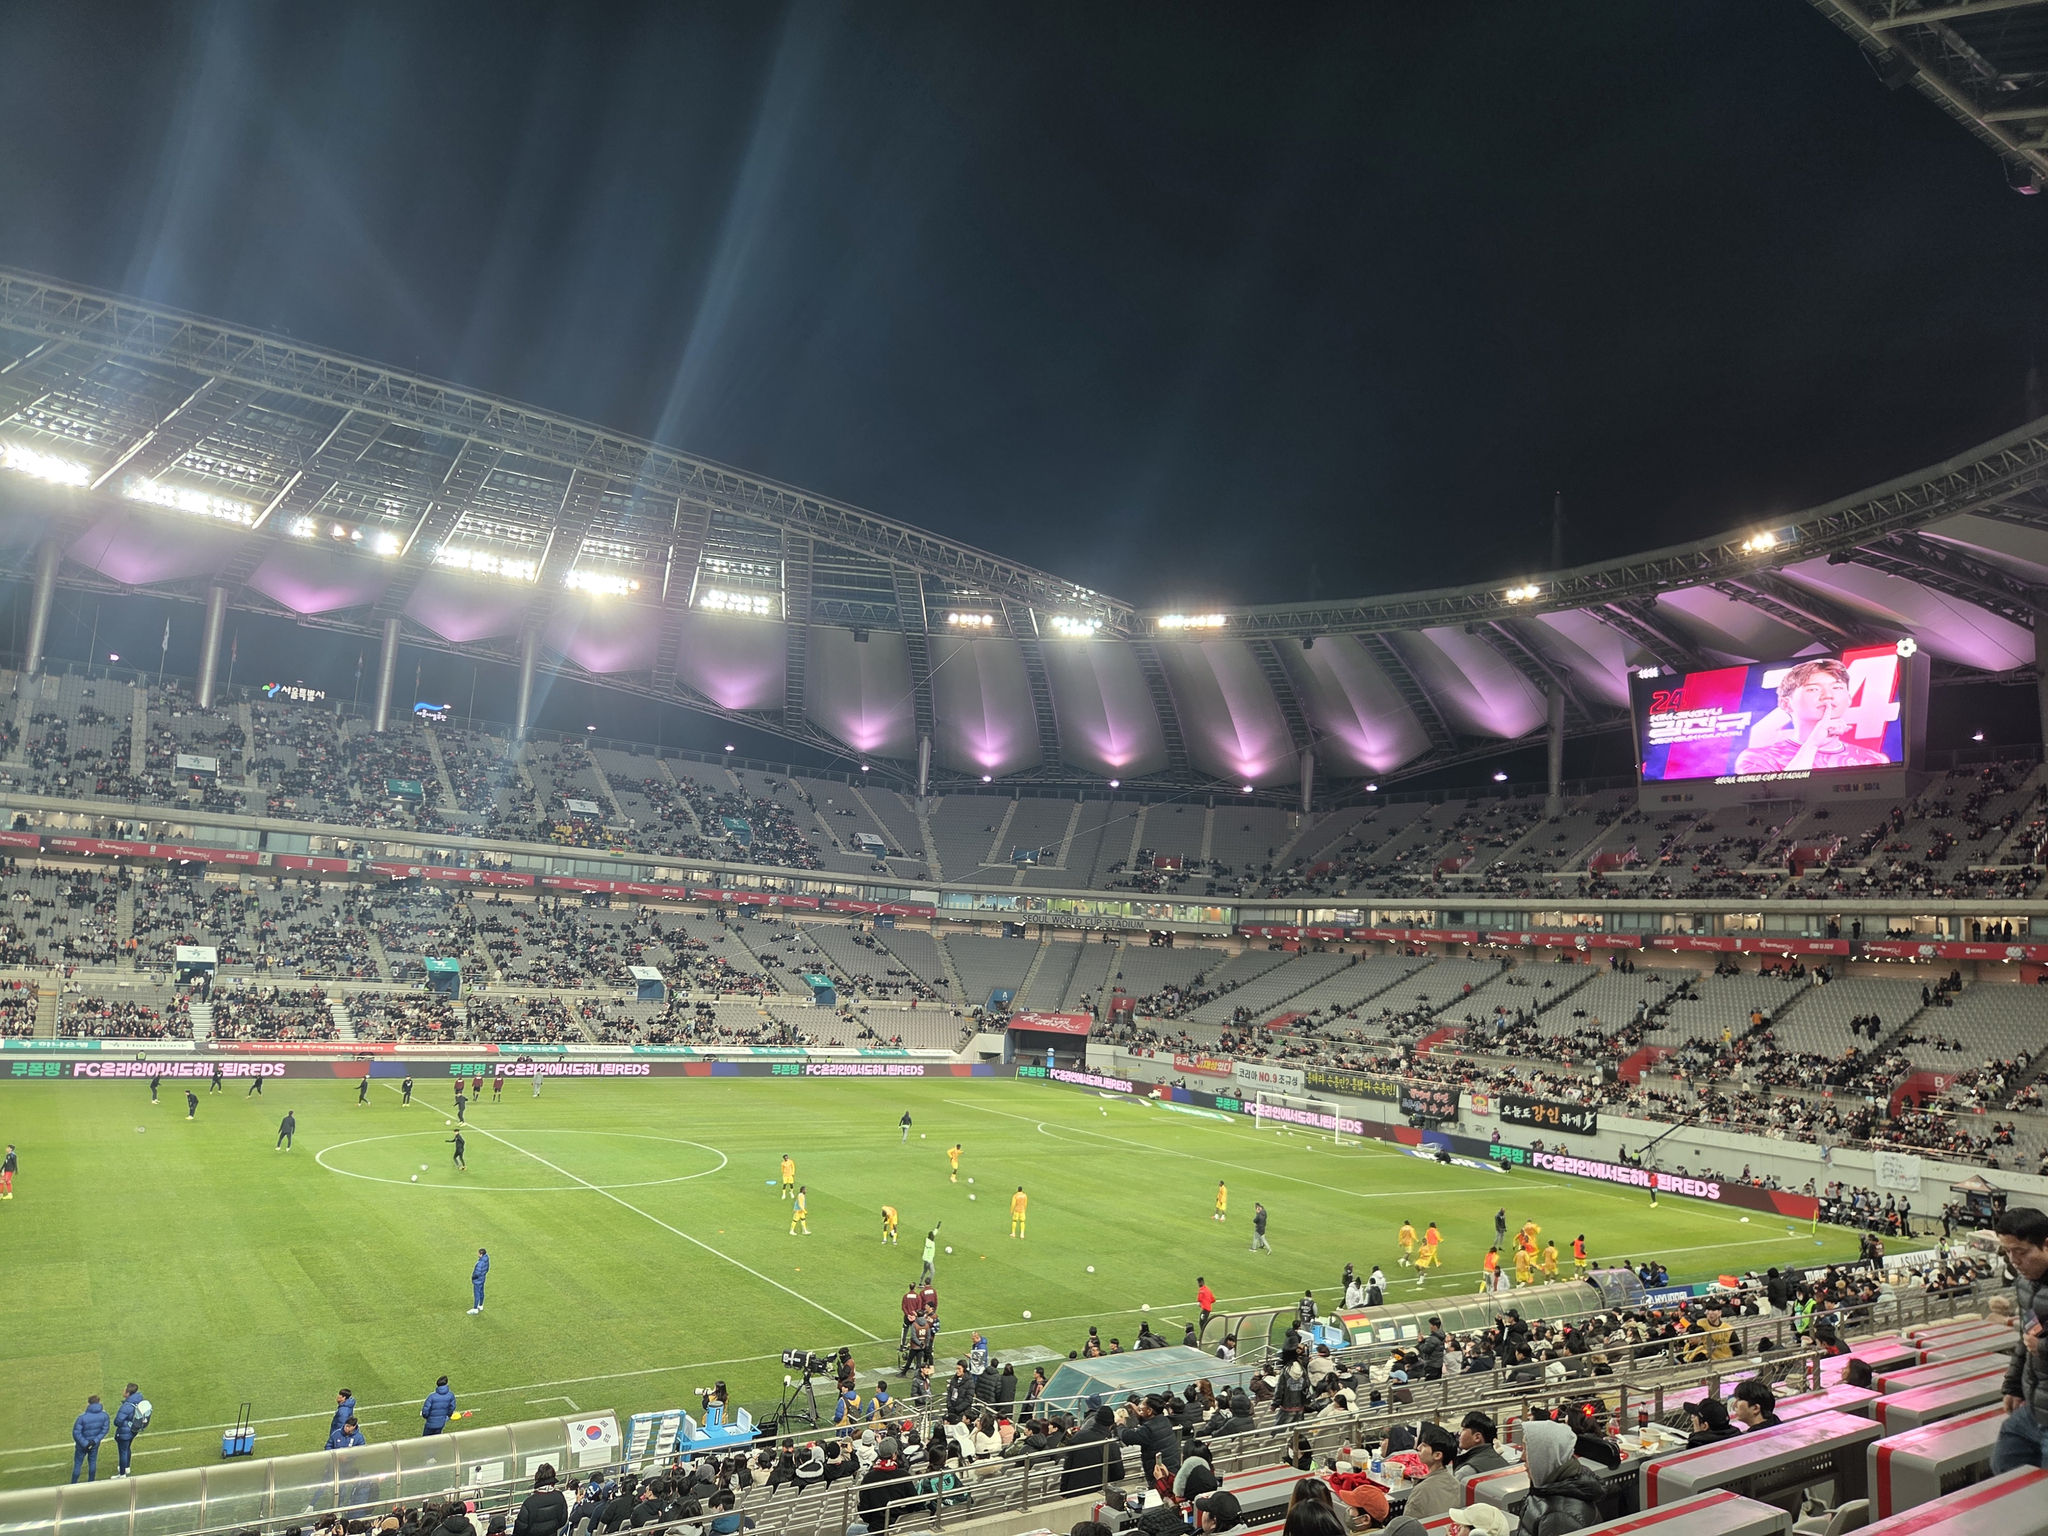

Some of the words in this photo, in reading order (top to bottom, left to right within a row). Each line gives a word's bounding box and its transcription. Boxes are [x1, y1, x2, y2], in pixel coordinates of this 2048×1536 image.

[280, 685, 325, 702] 서울특별시
[1649, 688, 1687, 715] 24
[1650, 712, 1674, 722] KIM
[1649, 711, 1752, 738] 김진규
[1777, 771, 1811, 780] STADIUM
[1022, 914, 1049, 923] SEOUL
[1052, 916, 1082, 925] WORLD
[1085, 917, 1102, 926] CUP
[1105, 919, 1144, 928] STADIUM
[11, 1062, 61, 1077] 쿠폰명
[449, 1063, 486, 1076] 쿠폰명
[772, 1064, 800, 1076] 쿠폰명
[1018, 1066, 1046, 1078] 쿠폰명
[1238, 1067, 1258, 1078] 코리아
[1258, 1071, 1278, 1083] NO.9
[1278, 1074, 1298, 1087] 조규성
[1934, 1076, 1944, 1088] B
[1215, 1097, 1239, 1111] 쿠폰명
[1501, 1105, 1532, 1119] 오늘도
[1489, 1144, 1525, 1164] 쿠폰명
